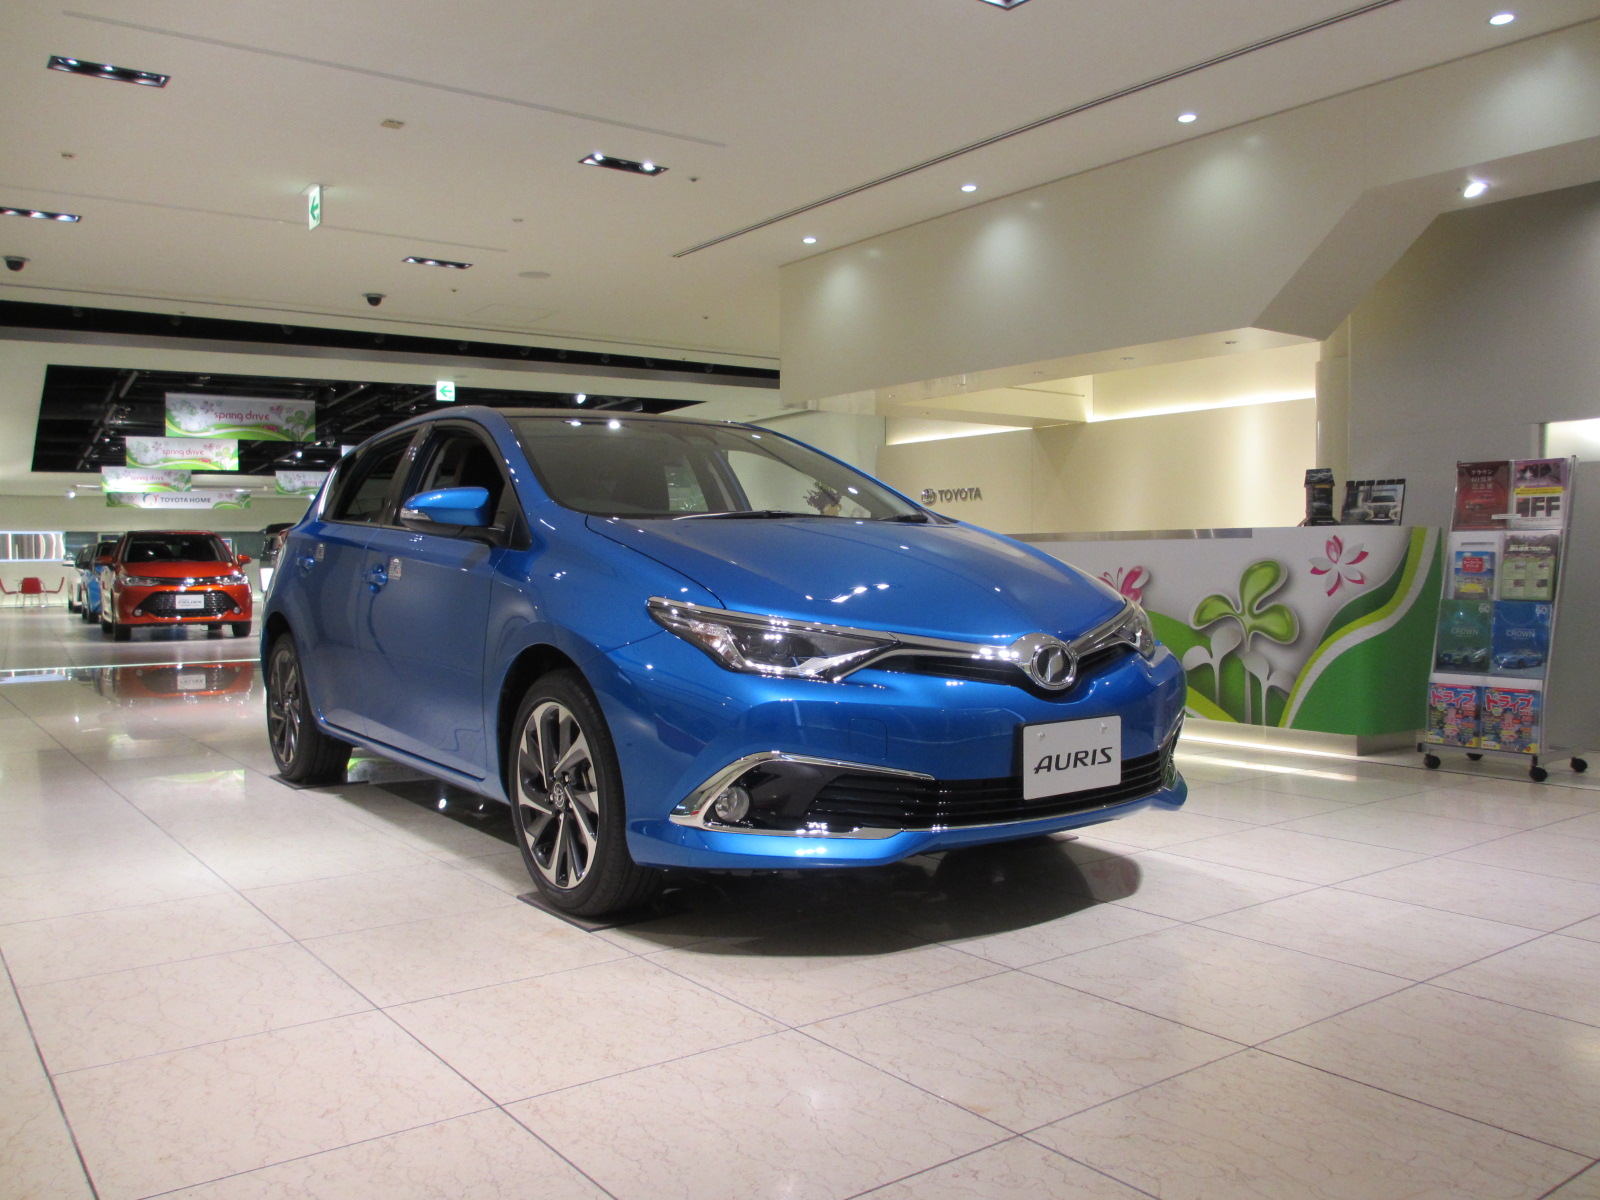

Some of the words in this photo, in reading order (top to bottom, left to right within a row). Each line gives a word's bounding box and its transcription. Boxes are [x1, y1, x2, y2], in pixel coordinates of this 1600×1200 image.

[214, 411, 243, 422] spring
[245, 411, 270, 421] drive
[162, 447, 184, 457] spring
[185, 447, 204, 456] drive
[937, 487, 983, 503] TOYOTA
[1450, 627, 1479, 636] CROWN
[1505, 629, 1536, 638] CROWN
[1033, 746, 1113, 774] AURIS
